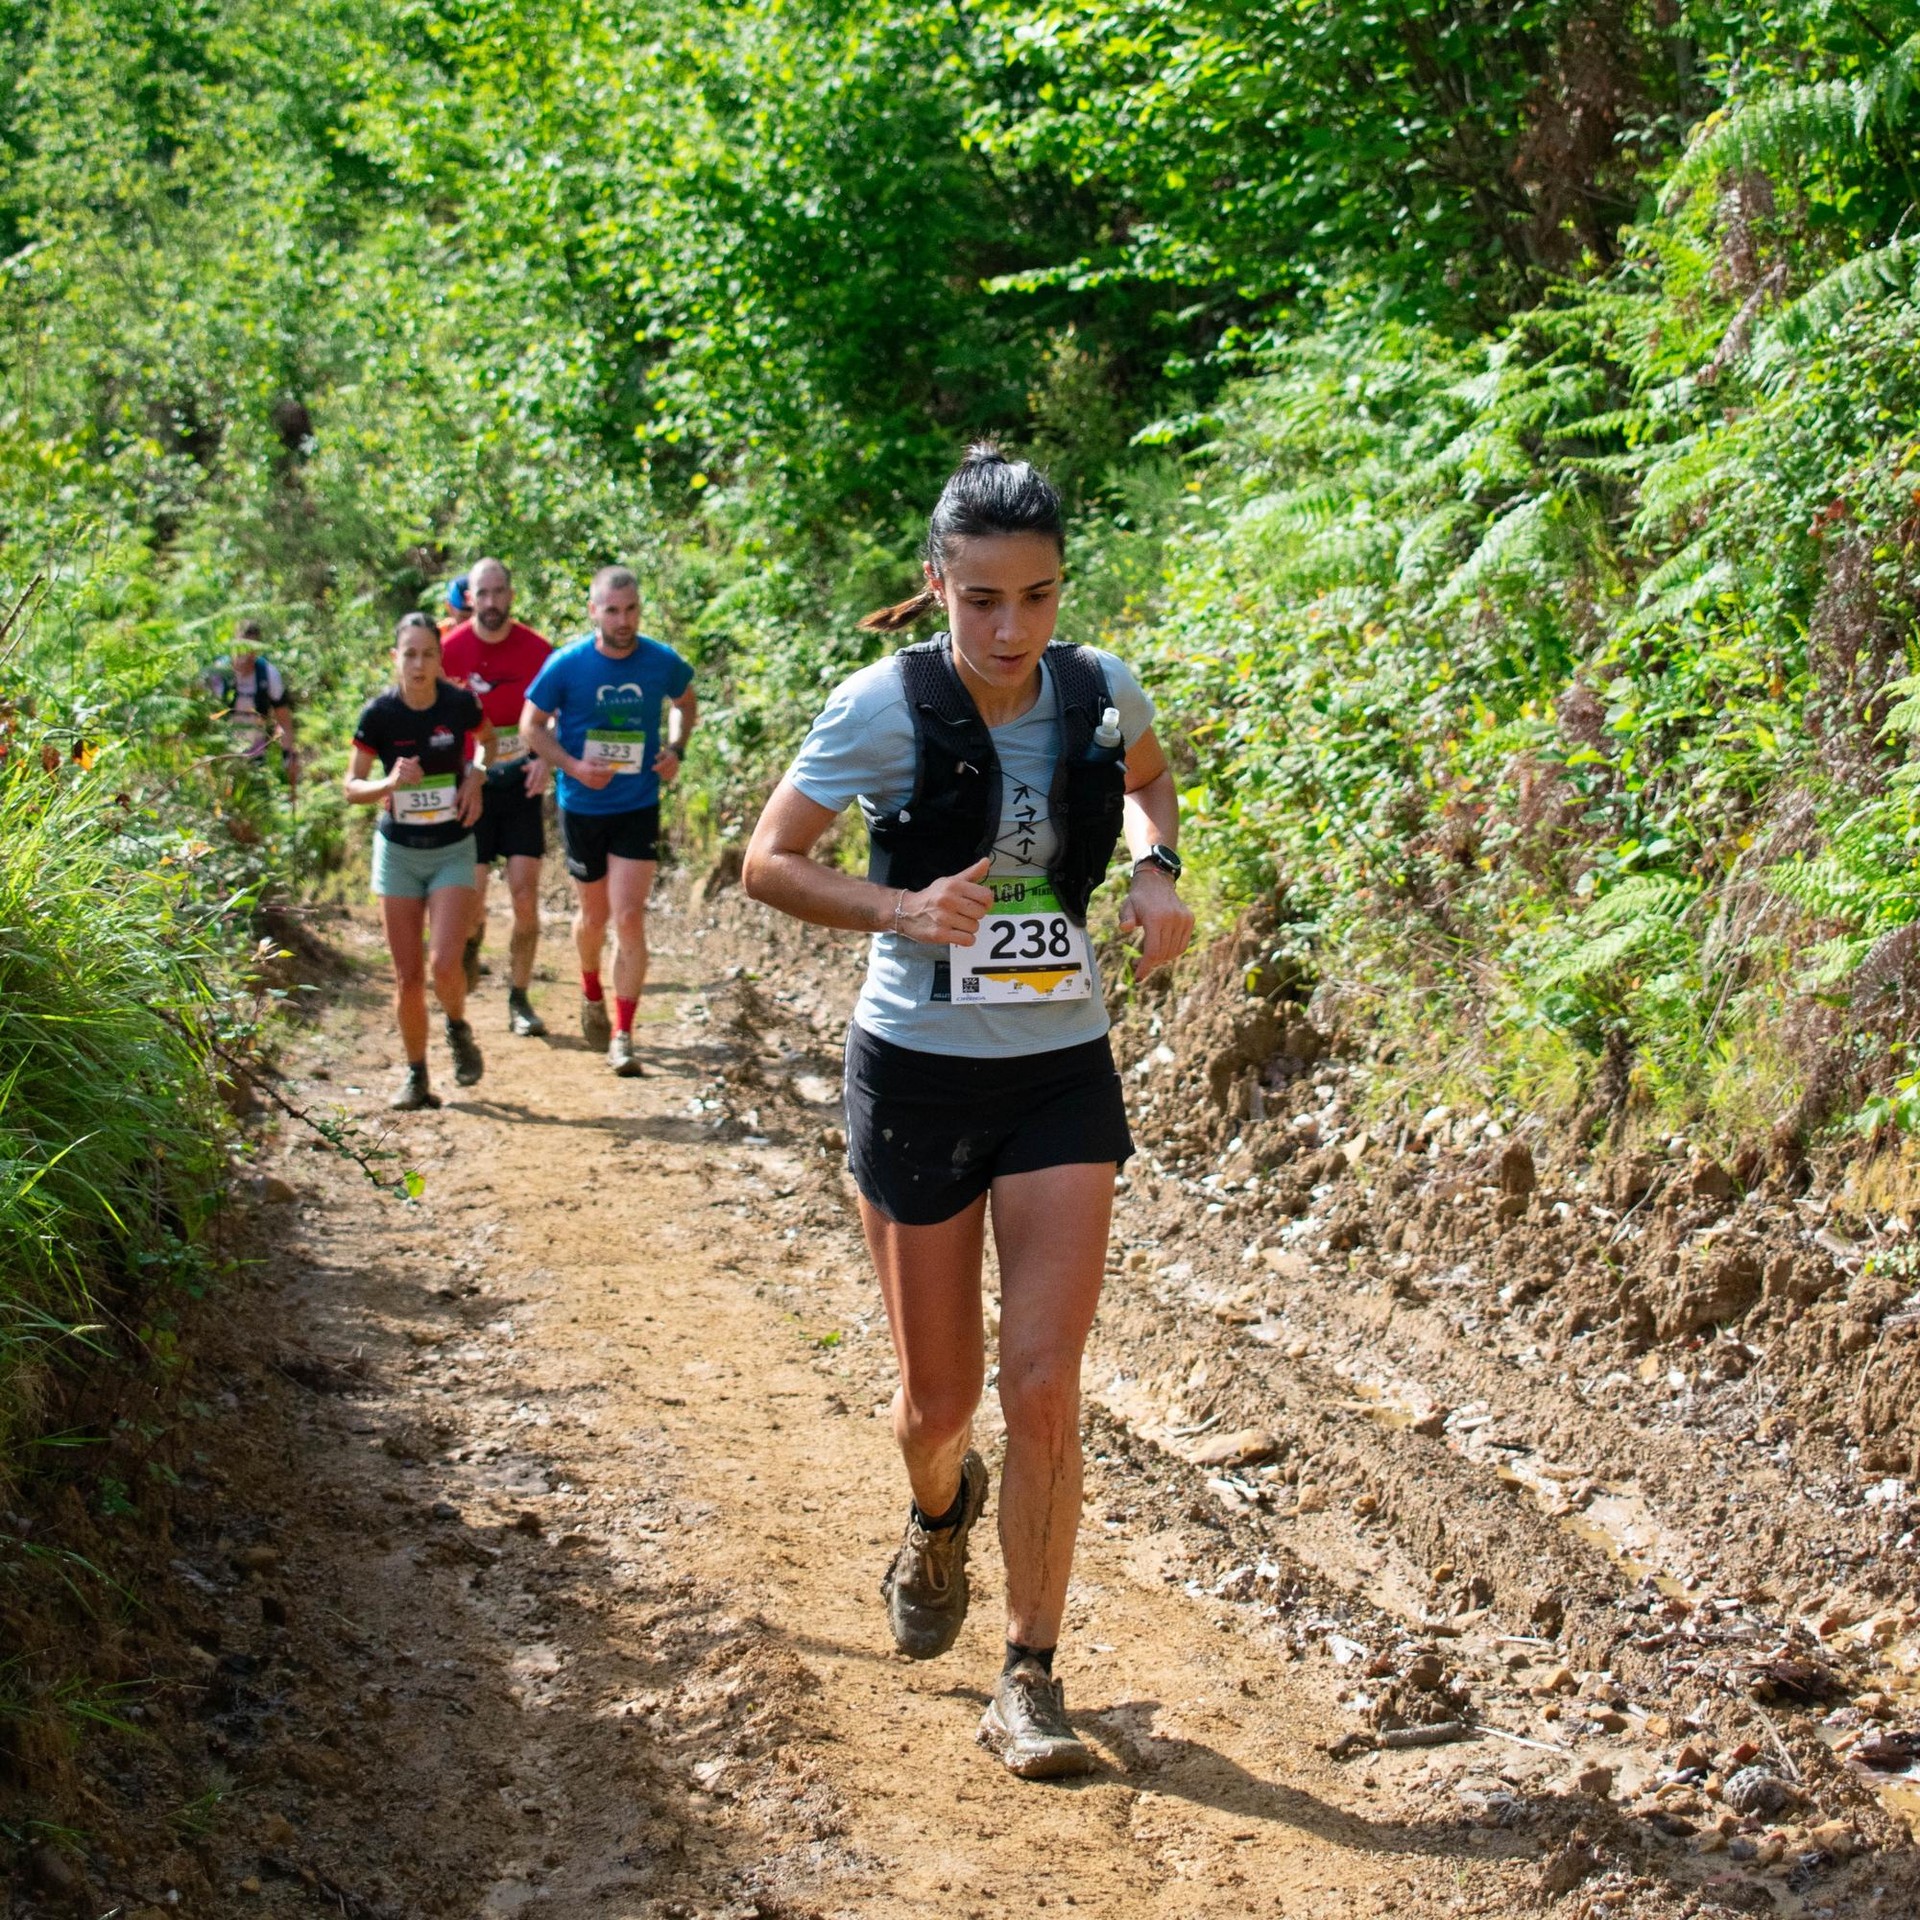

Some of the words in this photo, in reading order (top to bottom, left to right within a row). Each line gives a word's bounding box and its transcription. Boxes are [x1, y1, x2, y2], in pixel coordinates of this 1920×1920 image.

[599, 743, 631, 759] 323
[410, 791, 442, 808] 315
[990, 918, 1070, 959] 238
